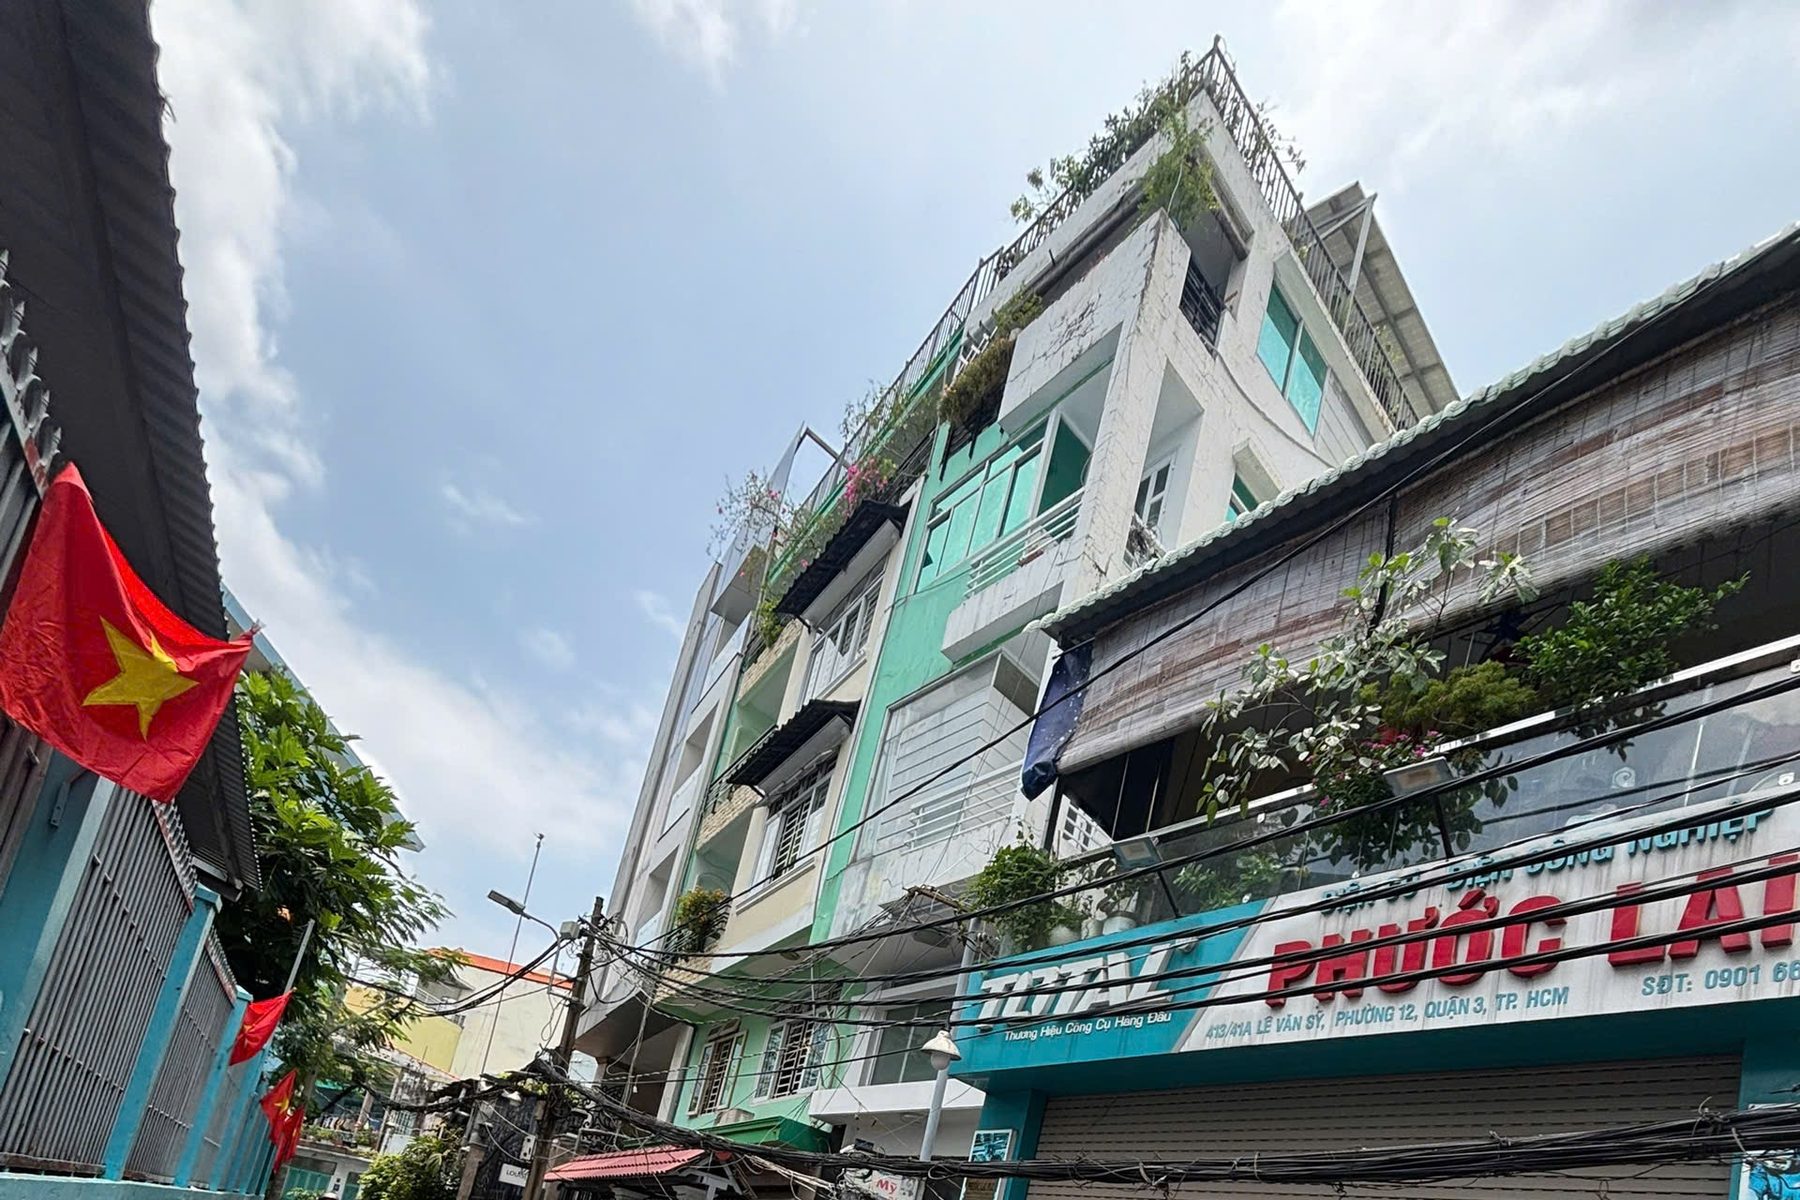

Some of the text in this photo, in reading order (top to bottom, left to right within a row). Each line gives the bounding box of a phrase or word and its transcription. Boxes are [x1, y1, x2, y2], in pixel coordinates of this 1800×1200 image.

[1265, 888, 1567, 1008] PHƯỚC
[977, 943, 1173, 1030] TOTAL
[1641, 972, 1693, 996] SĐT:
[1704, 964, 1760, 989] 0901
[1004, 1029, 1038, 1041] Thương
[1040, 1026, 1063, 1037] Hiệu
[1065, 1021, 1092, 1034] Công
[1095, 1018, 1112, 1030] Cụ
[1115, 1014, 1144, 1028] Hàng
[1256, 1015, 1273, 1035] LÊ
[1276, 1015, 1301, 1033] VĂN
[1335, 1003, 1395, 1027] PHƯỜNG
[1399, 1003, 1418, 1022] 12,
[1424, 995, 1470, 1020] QUẬN
[1473, 996, 1487, 1015] 3,
[1495, 992, 1518, 1011] TP.
[1525, 986, 1570, 1008] HCM
